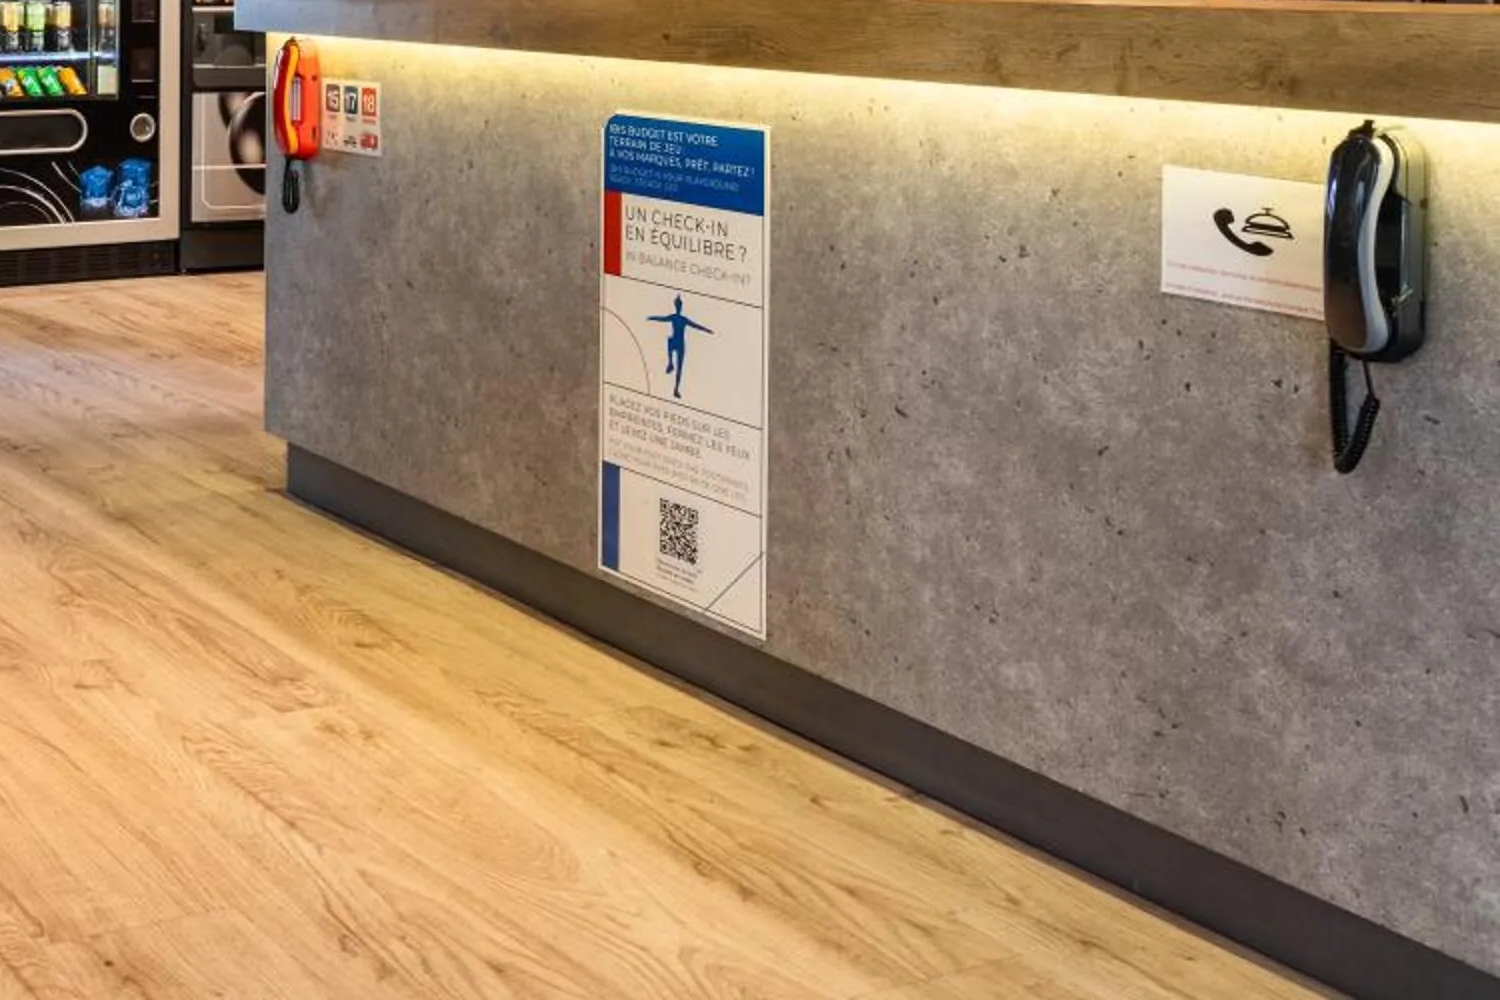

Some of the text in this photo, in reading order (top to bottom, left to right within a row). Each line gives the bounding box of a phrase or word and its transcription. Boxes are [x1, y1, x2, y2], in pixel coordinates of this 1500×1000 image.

[685, 133, 719, 147] VOTRE
[626, 206, 728, 237] UN CHECK-IN
[625, 225, 645, 242] EN
